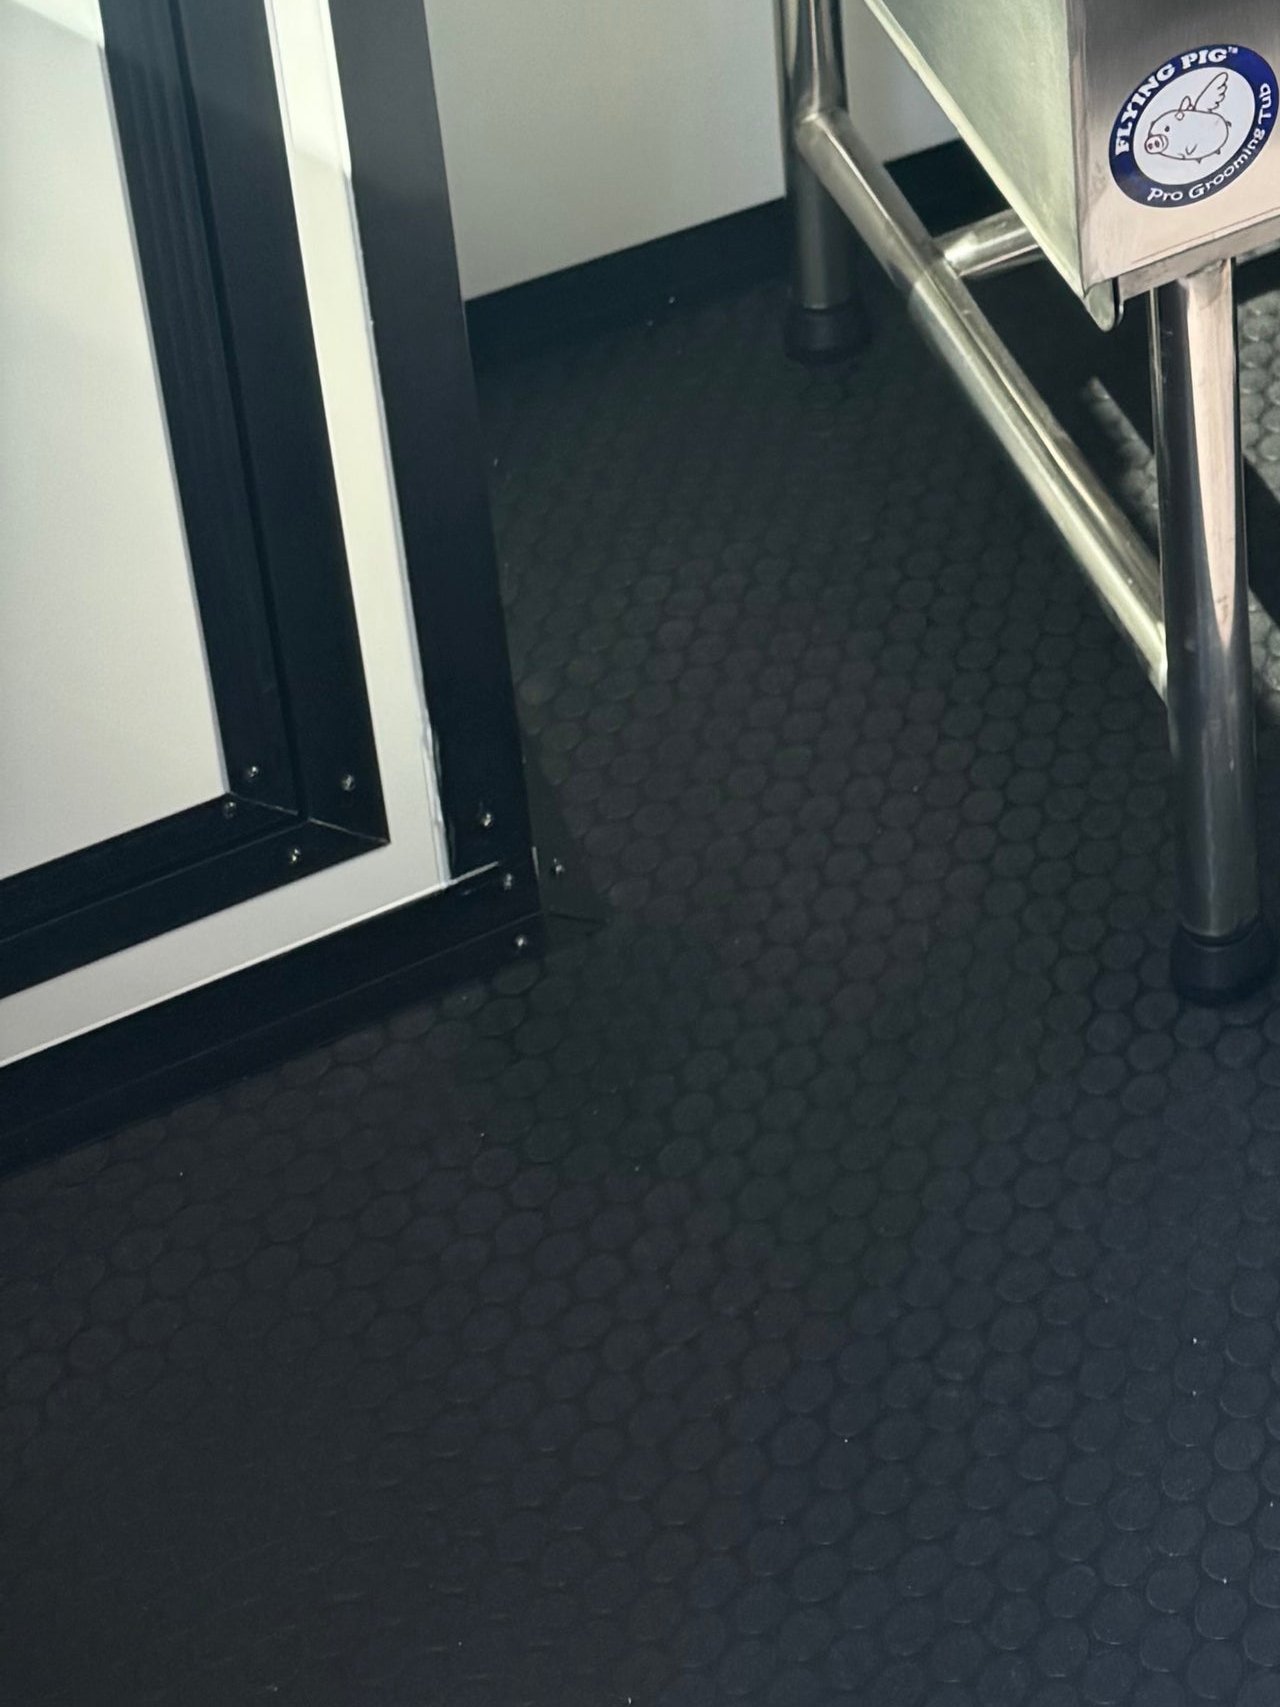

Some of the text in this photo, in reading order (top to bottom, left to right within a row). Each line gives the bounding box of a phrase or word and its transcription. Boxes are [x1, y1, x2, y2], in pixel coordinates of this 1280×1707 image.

[1115, 64, 1175, 155] FLYING
[1147, 83, 1272, 202] Pro Grooming Tub
